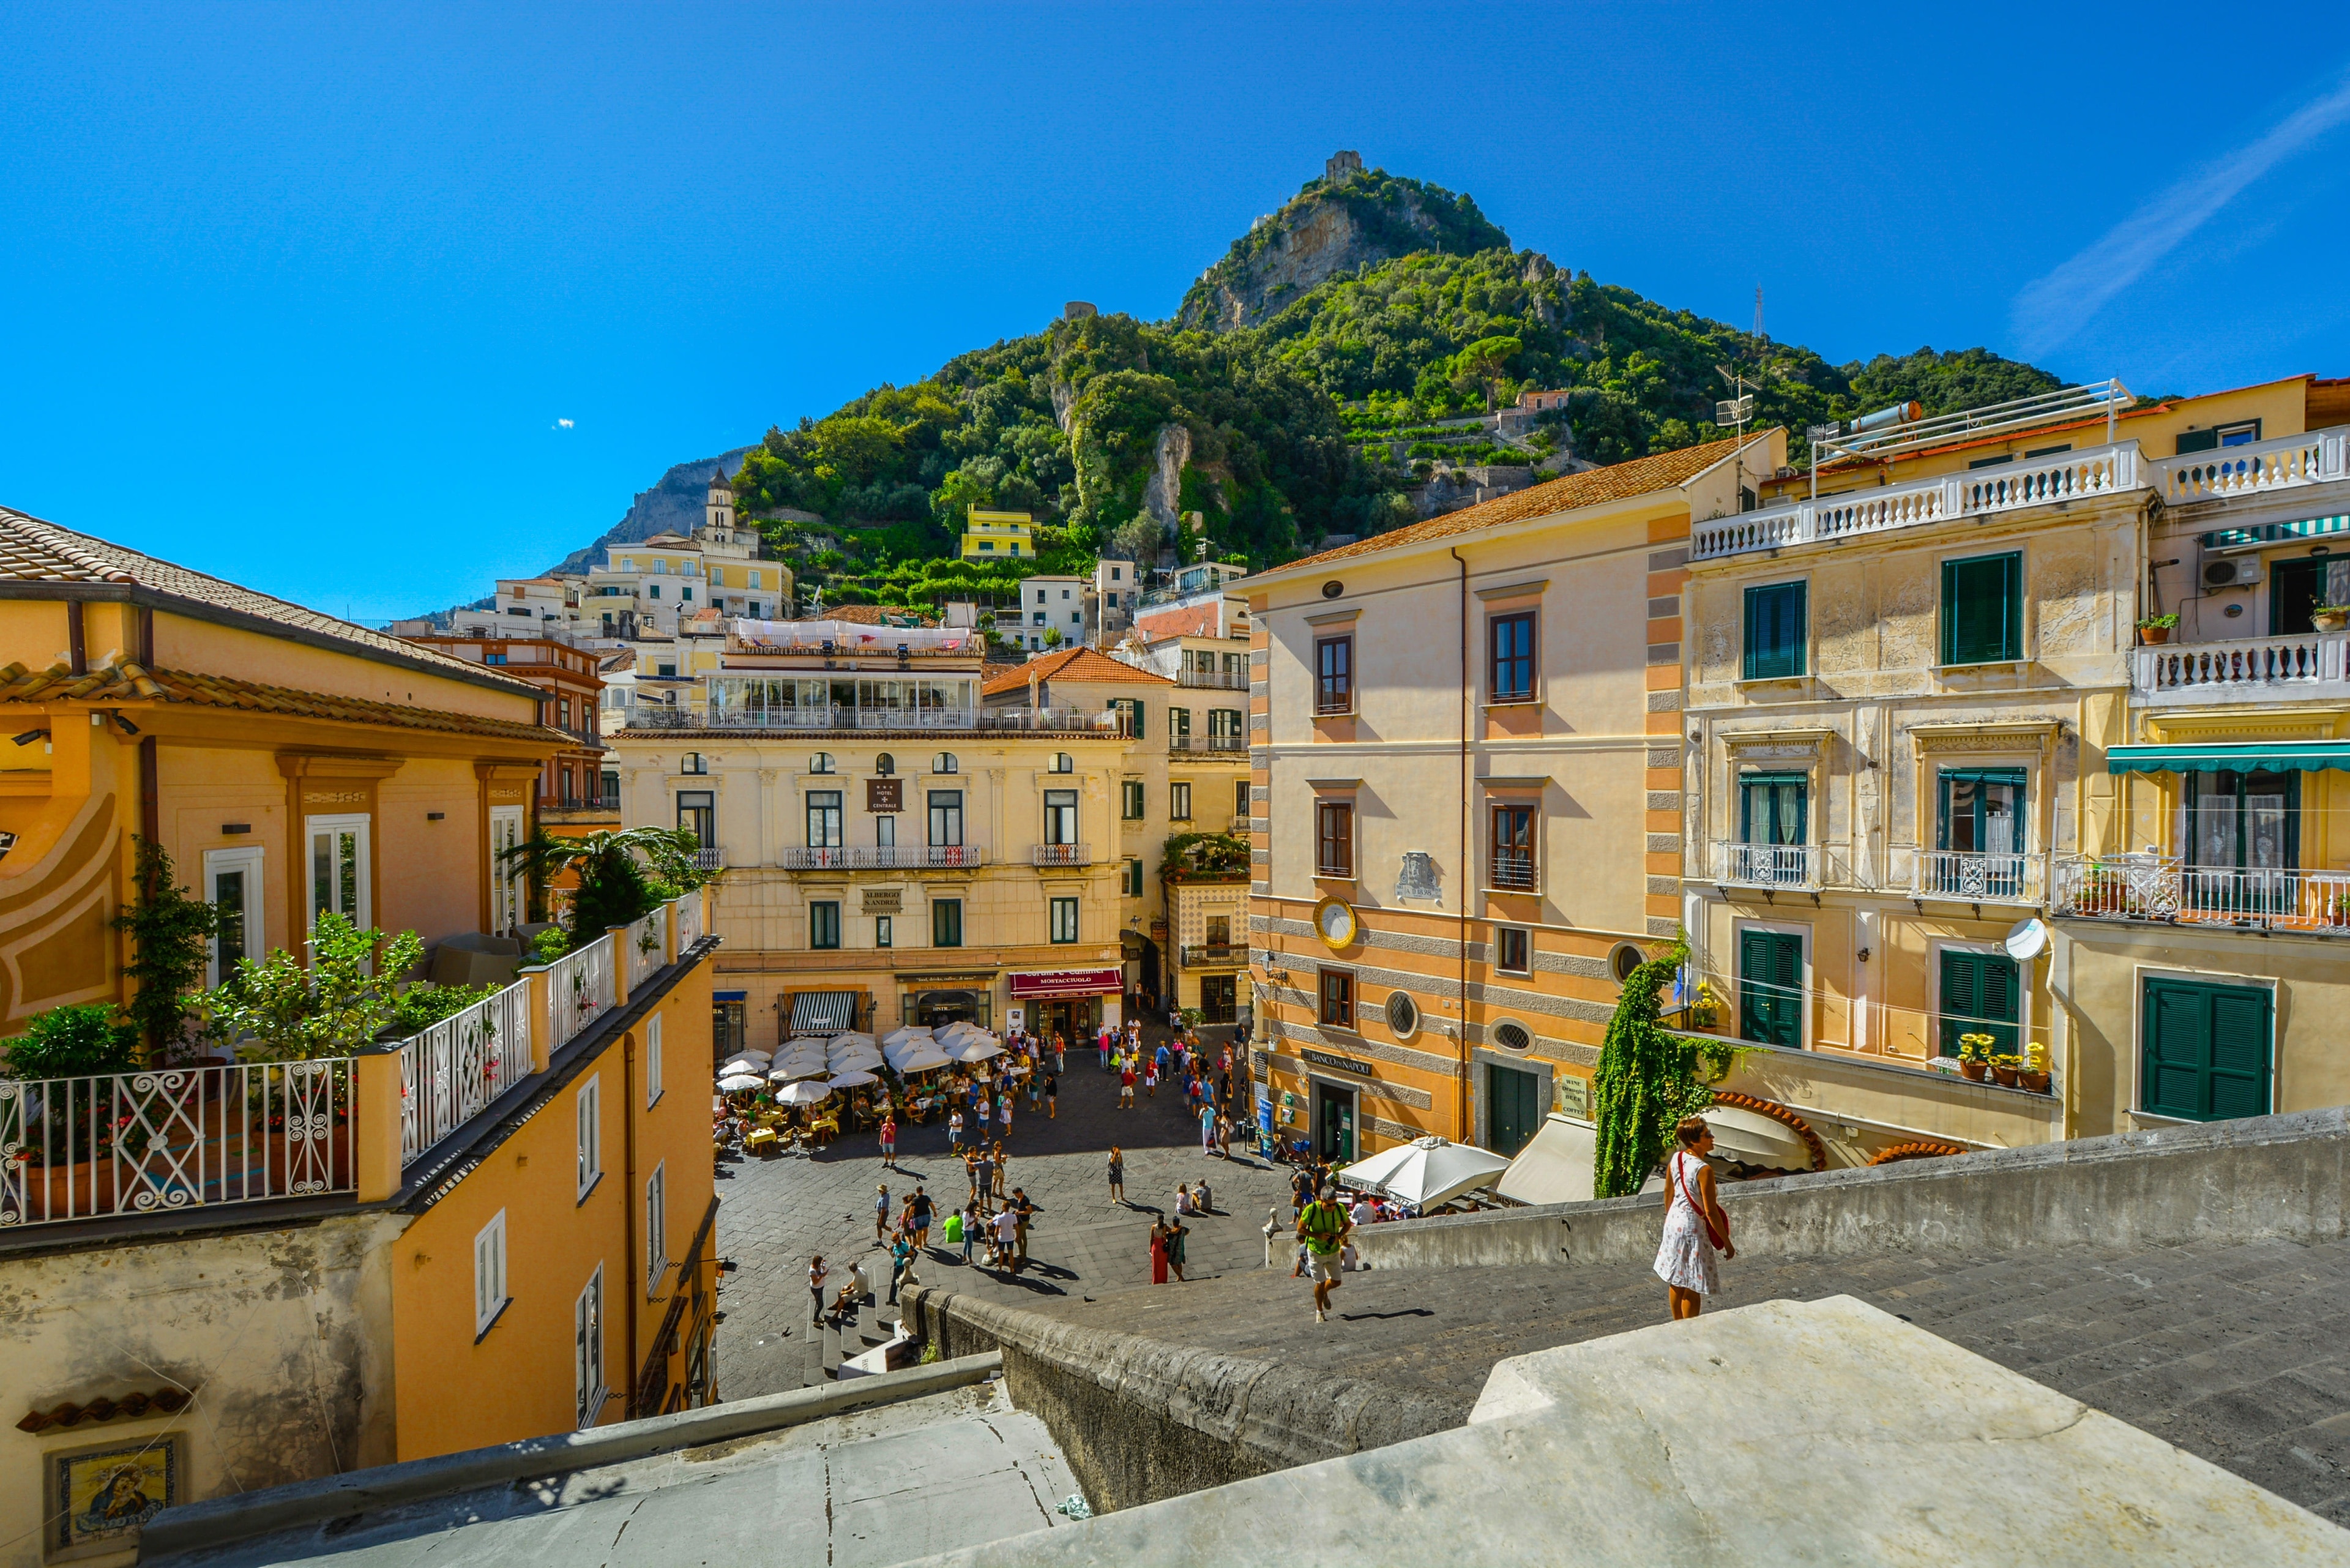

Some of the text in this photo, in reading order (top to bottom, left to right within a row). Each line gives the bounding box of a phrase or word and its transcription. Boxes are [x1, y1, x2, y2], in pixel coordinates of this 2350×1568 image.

[1311, 1053, 1336, 1066] BANCO
[1342, 1061, 1369, 1073] NAPOLI
[1562, 1086, 1586, 1095] Draught
[1563, 1107, 1585, 1116] COFFEE
[1343, 1178, 1364, 1189] LIGHT
[1394, 1195, 1414, 1210] PIZZA
